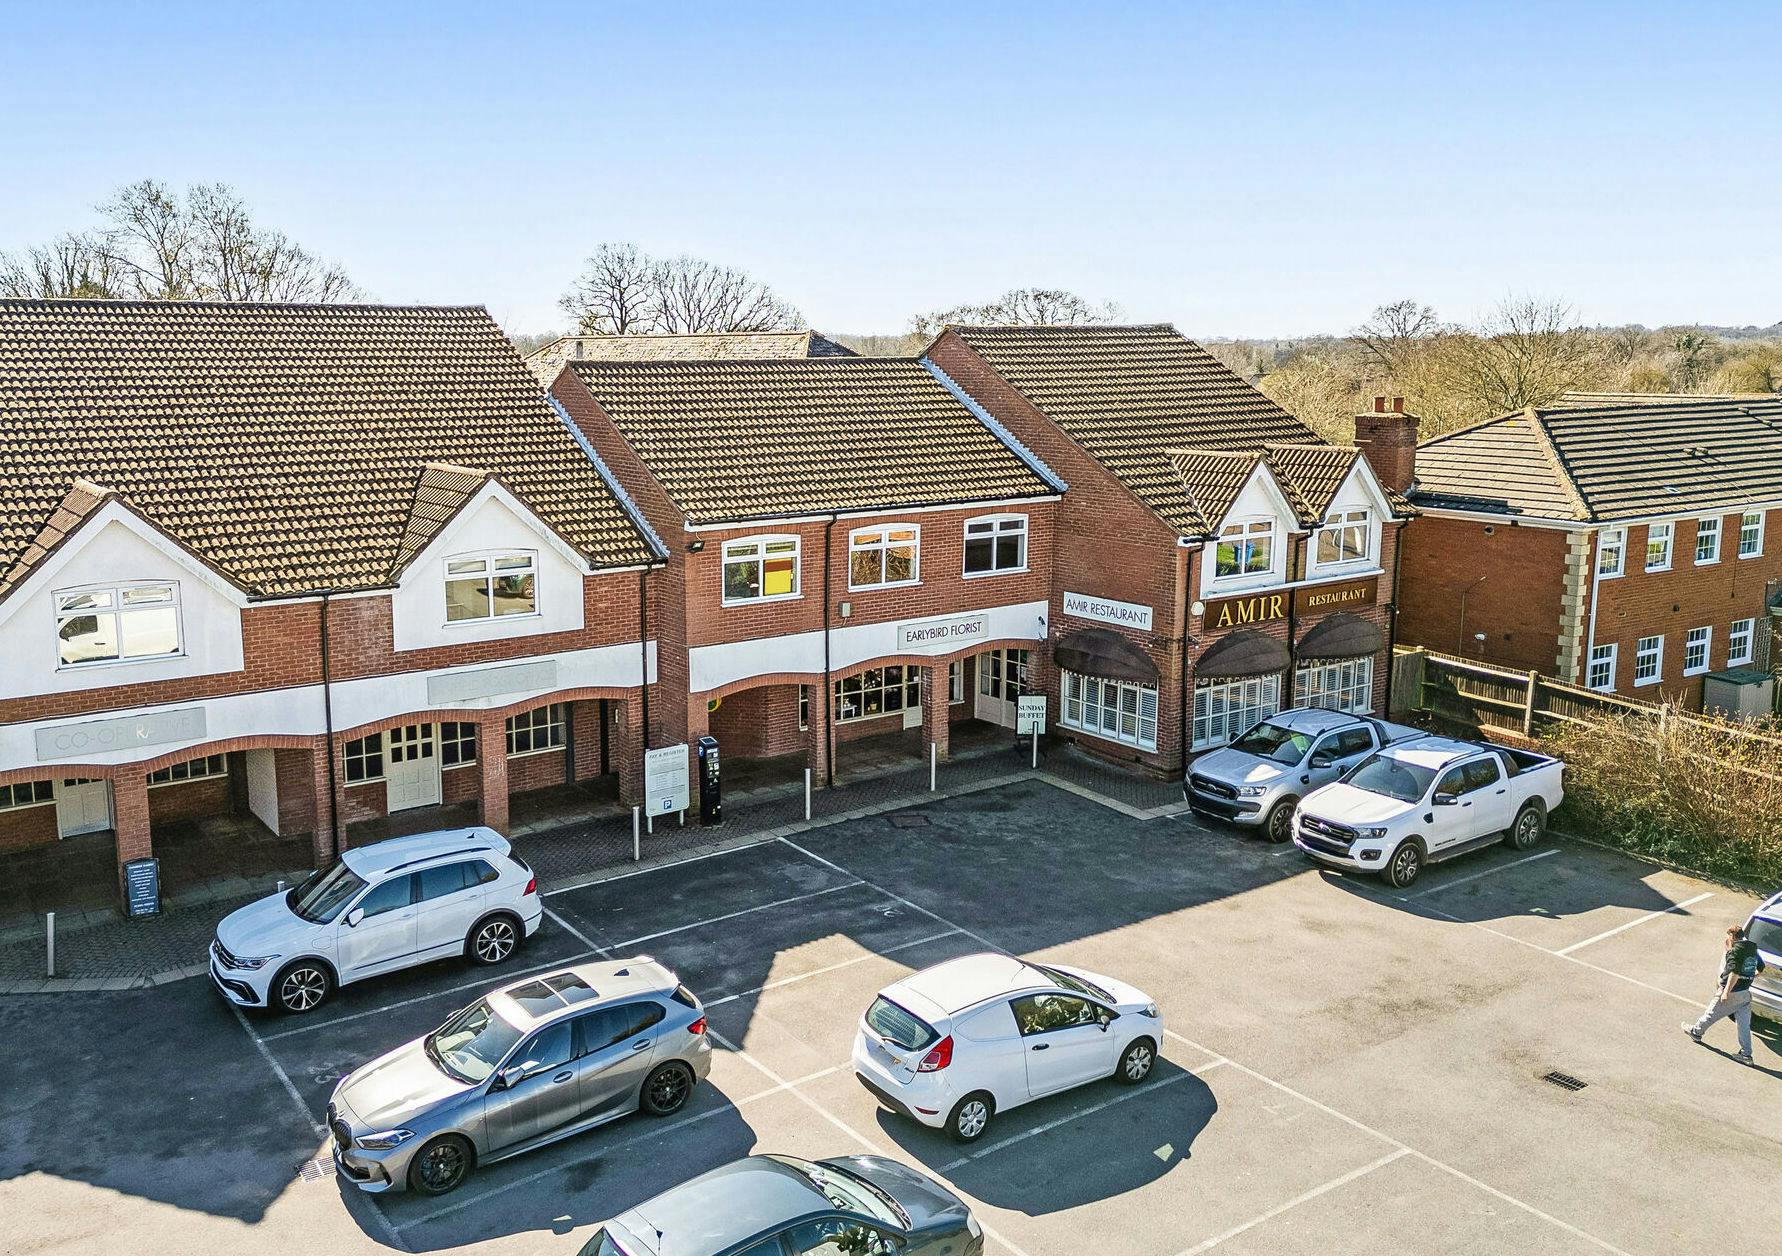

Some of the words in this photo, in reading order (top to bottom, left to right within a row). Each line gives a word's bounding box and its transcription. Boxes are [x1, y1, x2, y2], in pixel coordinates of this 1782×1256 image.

[1308, 588, 1367, 607] RESTAURANT
[1065, 599, 1088, 612] AMIR
[1090, 602, 1148, 624] RESTAURANT
[1216, 595, 1283, 628] AMIR
[906, 626, 948, 642] EARLYBIRD
[950, 621, 982, 635] FLORIST
